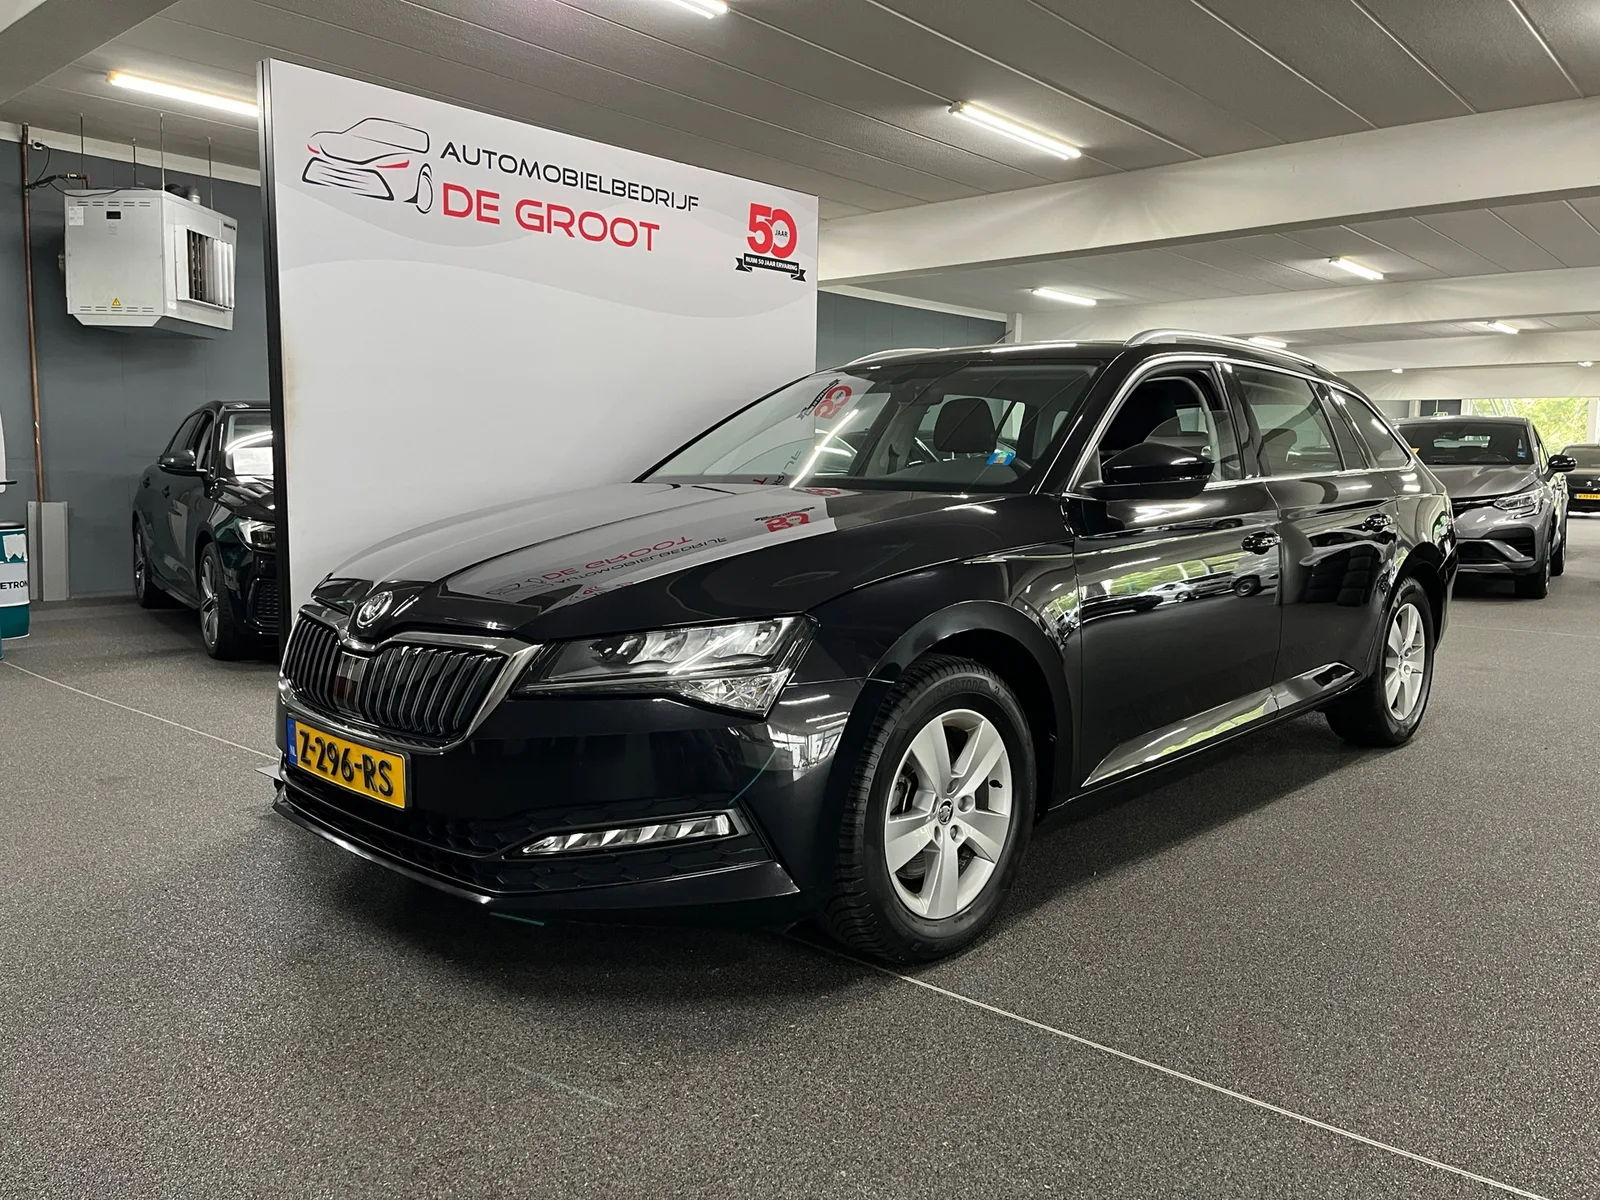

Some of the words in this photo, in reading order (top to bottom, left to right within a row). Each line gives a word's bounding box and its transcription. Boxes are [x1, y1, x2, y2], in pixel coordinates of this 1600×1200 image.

[440, 141, 699, 212] AUTOMOBIELBEDRIJF
[443, 182, 500, 225] DE
[515, 198, 660, 252] GROOT
[746, 202, 798, 259] 50
[775, 230, 788, 238] JAAR
[745, 256, 758, 264] RUIM
[776, 262, 798, 271] ERVARING
[299, 729, 394, 797] Z-296-RS
